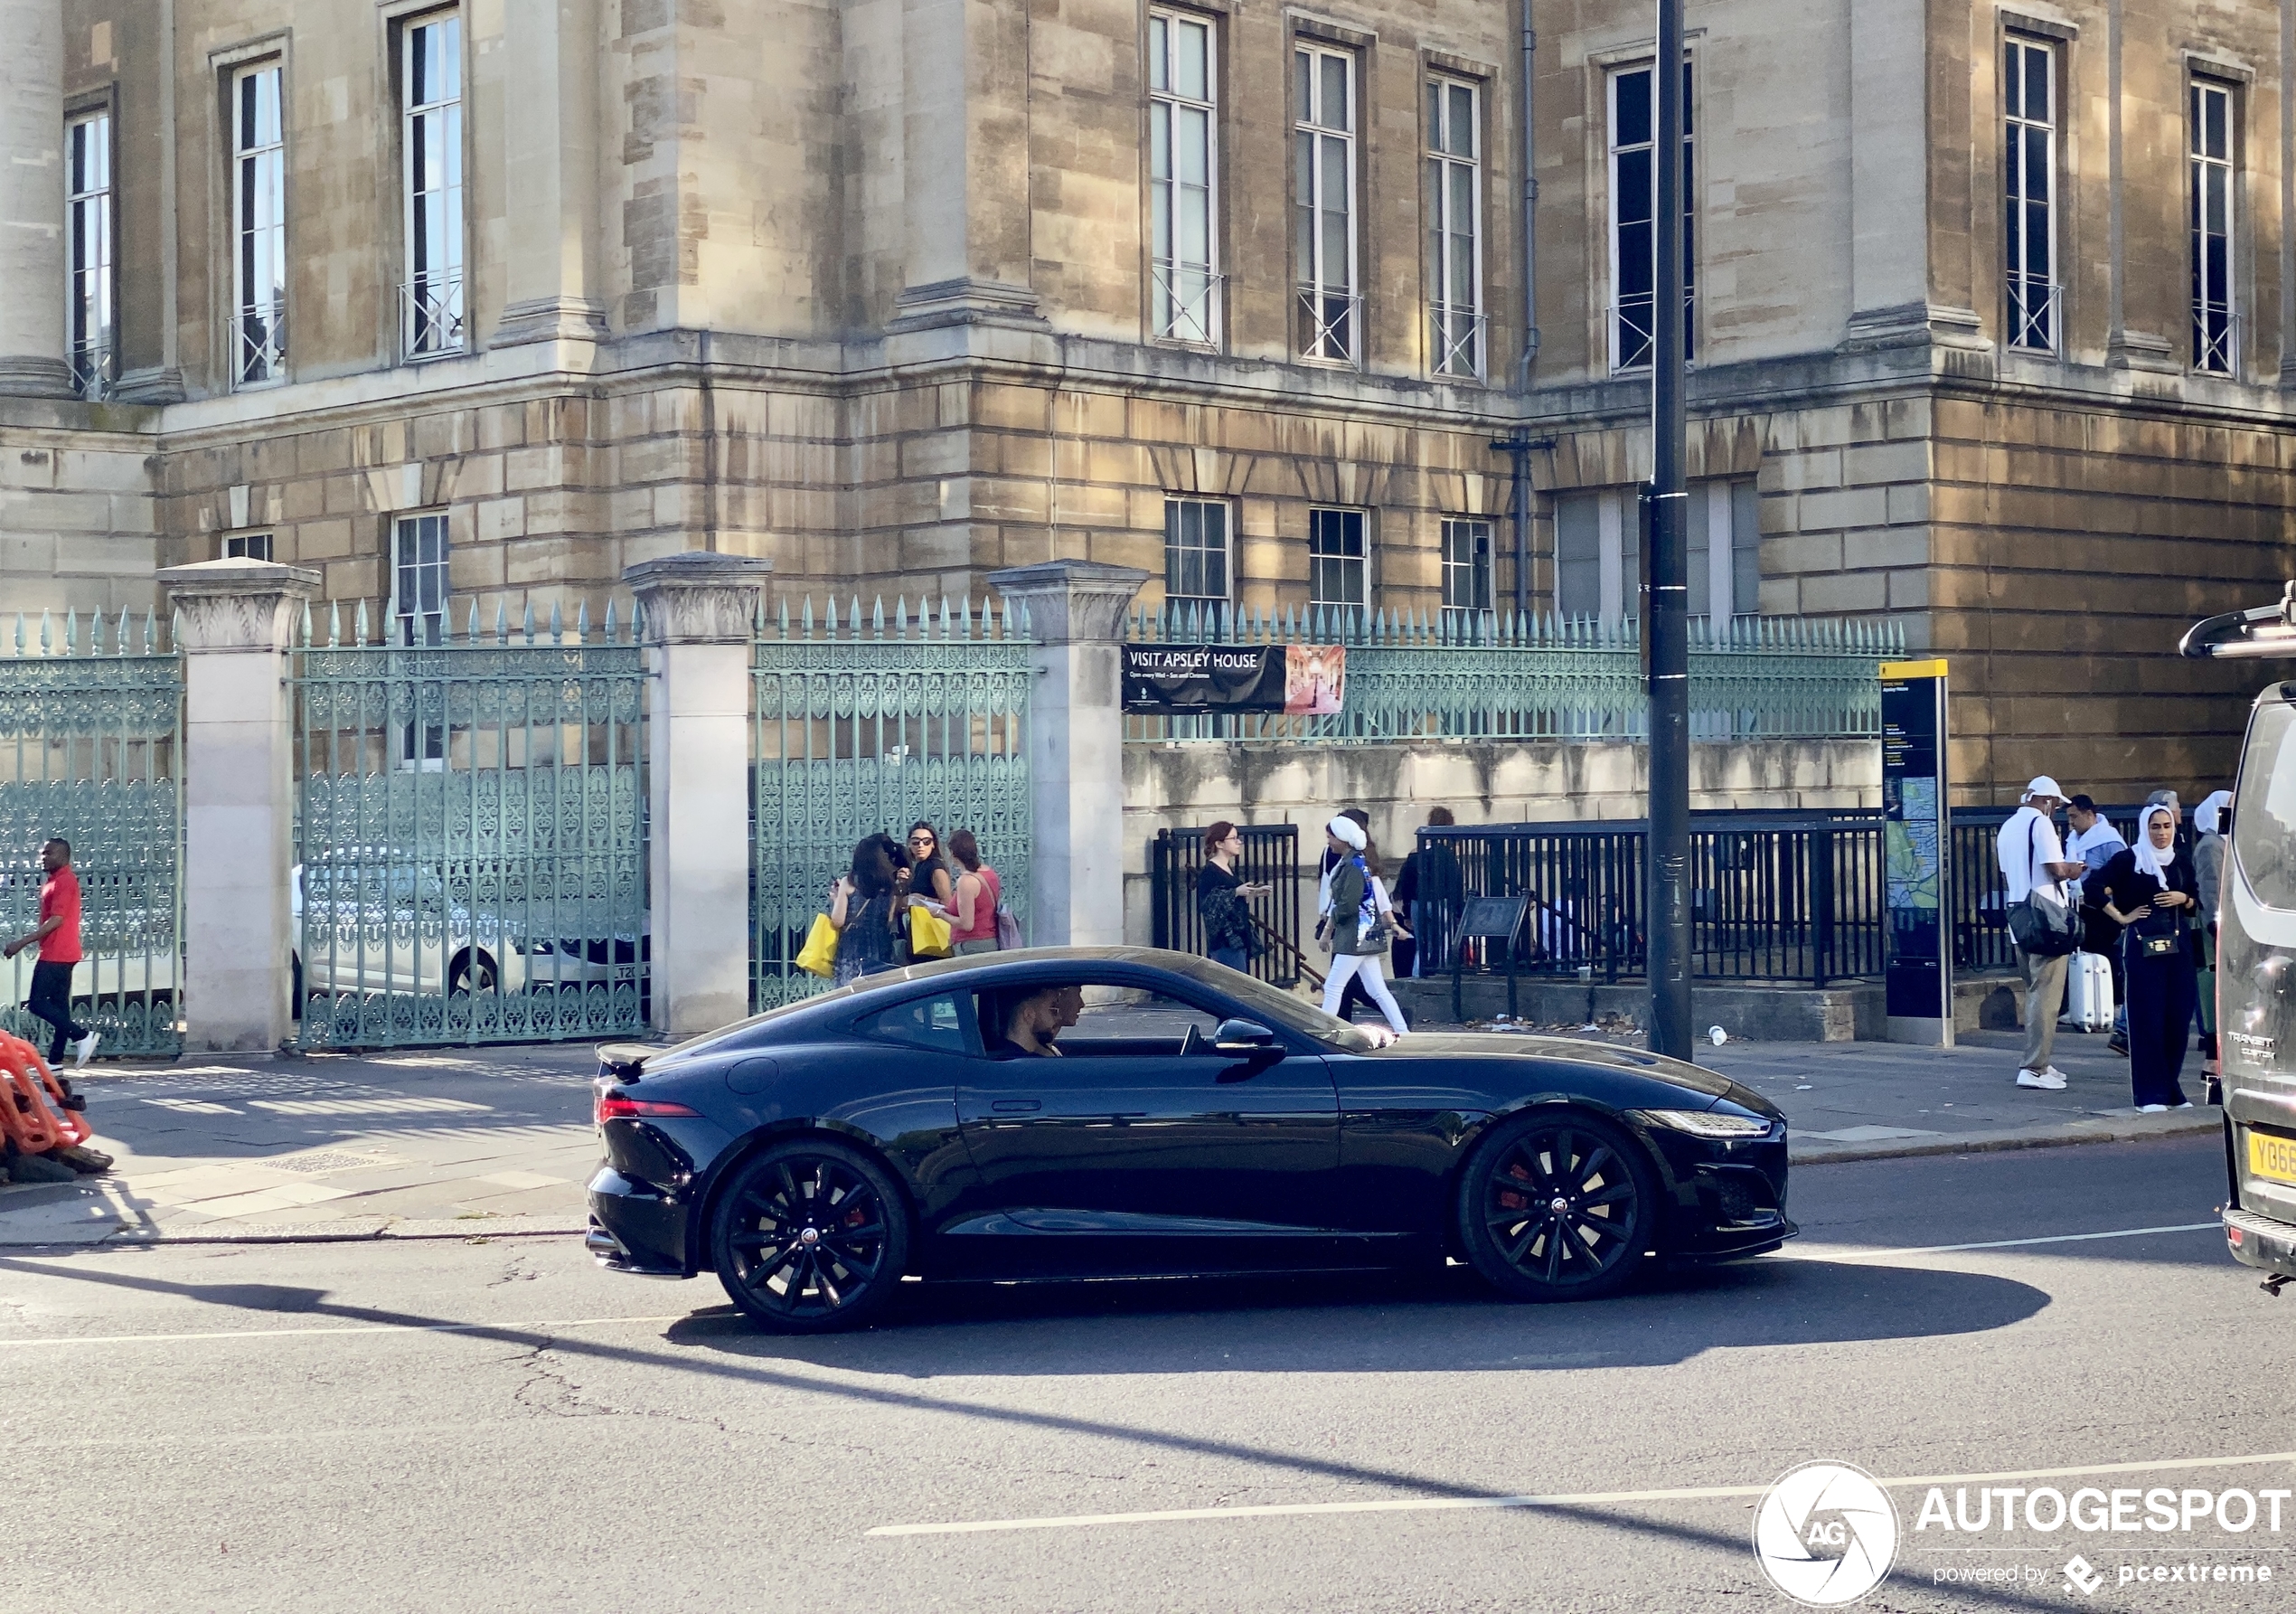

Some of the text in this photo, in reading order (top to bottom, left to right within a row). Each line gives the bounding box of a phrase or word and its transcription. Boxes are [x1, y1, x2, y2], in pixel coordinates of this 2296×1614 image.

[1129, 652, 1257, 668] VISIT APSLEY HOUSE
